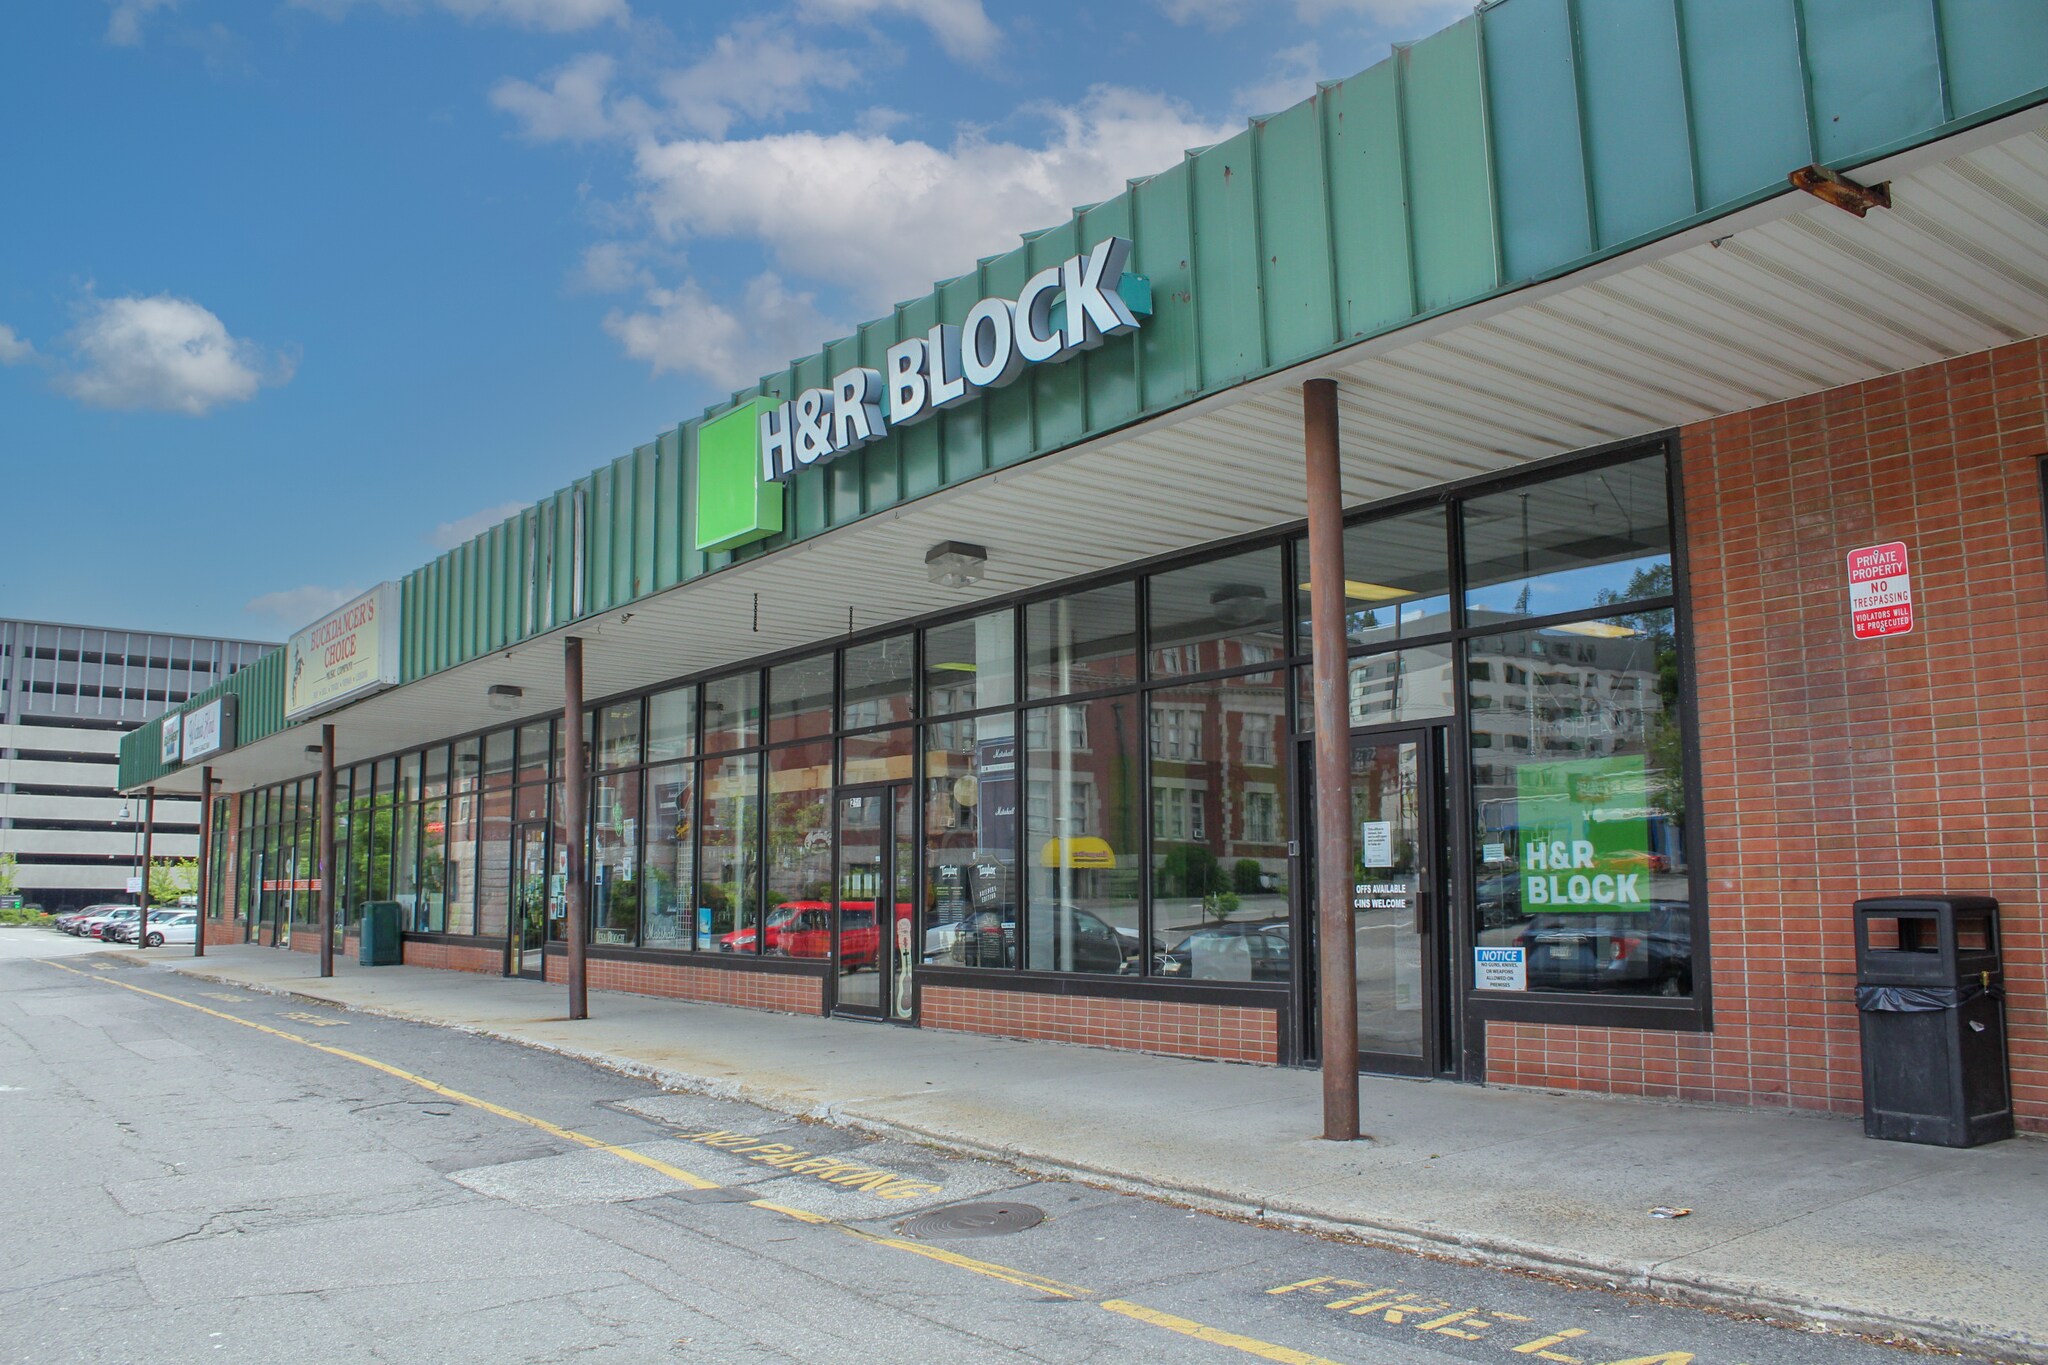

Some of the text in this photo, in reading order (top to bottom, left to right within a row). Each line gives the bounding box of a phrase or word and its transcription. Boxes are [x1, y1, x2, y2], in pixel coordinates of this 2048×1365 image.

[761, 237, 1140, 482] H&R BLOCK
[1856, 551, 1897, 568] PRIVATE
[1852, 562, 1903, 580] PROPERTY
[1871, 581, 1887, 593] NO
[1853, 591, 1909, 608] TRESPASSING
[1855, 608, 1909, 622] VIOLATORS WILL
[310, 598, 374, 652] BUCKDANCER'S
[1856, 617, 1909, 631] BE PROSECUTED
[324, 634, 357, 668] CHOICE
[1526, 840, 1595, 870] H&R
[940, 864, 958, 877] Taylor
[977, 864, 996, 877] Taylor
[1355, 884, 1406, 894] OFFS AVAILABLE
[1527, 873, 1641, 904] BLOCK
[1371, 899, 1406, 908] WELCOME
[1481, 950, 1518, 961] NOTICE
[671, 1130, 943, 1199] NO PARKING
[1265, 1276, 1535, 1341] FIRE
